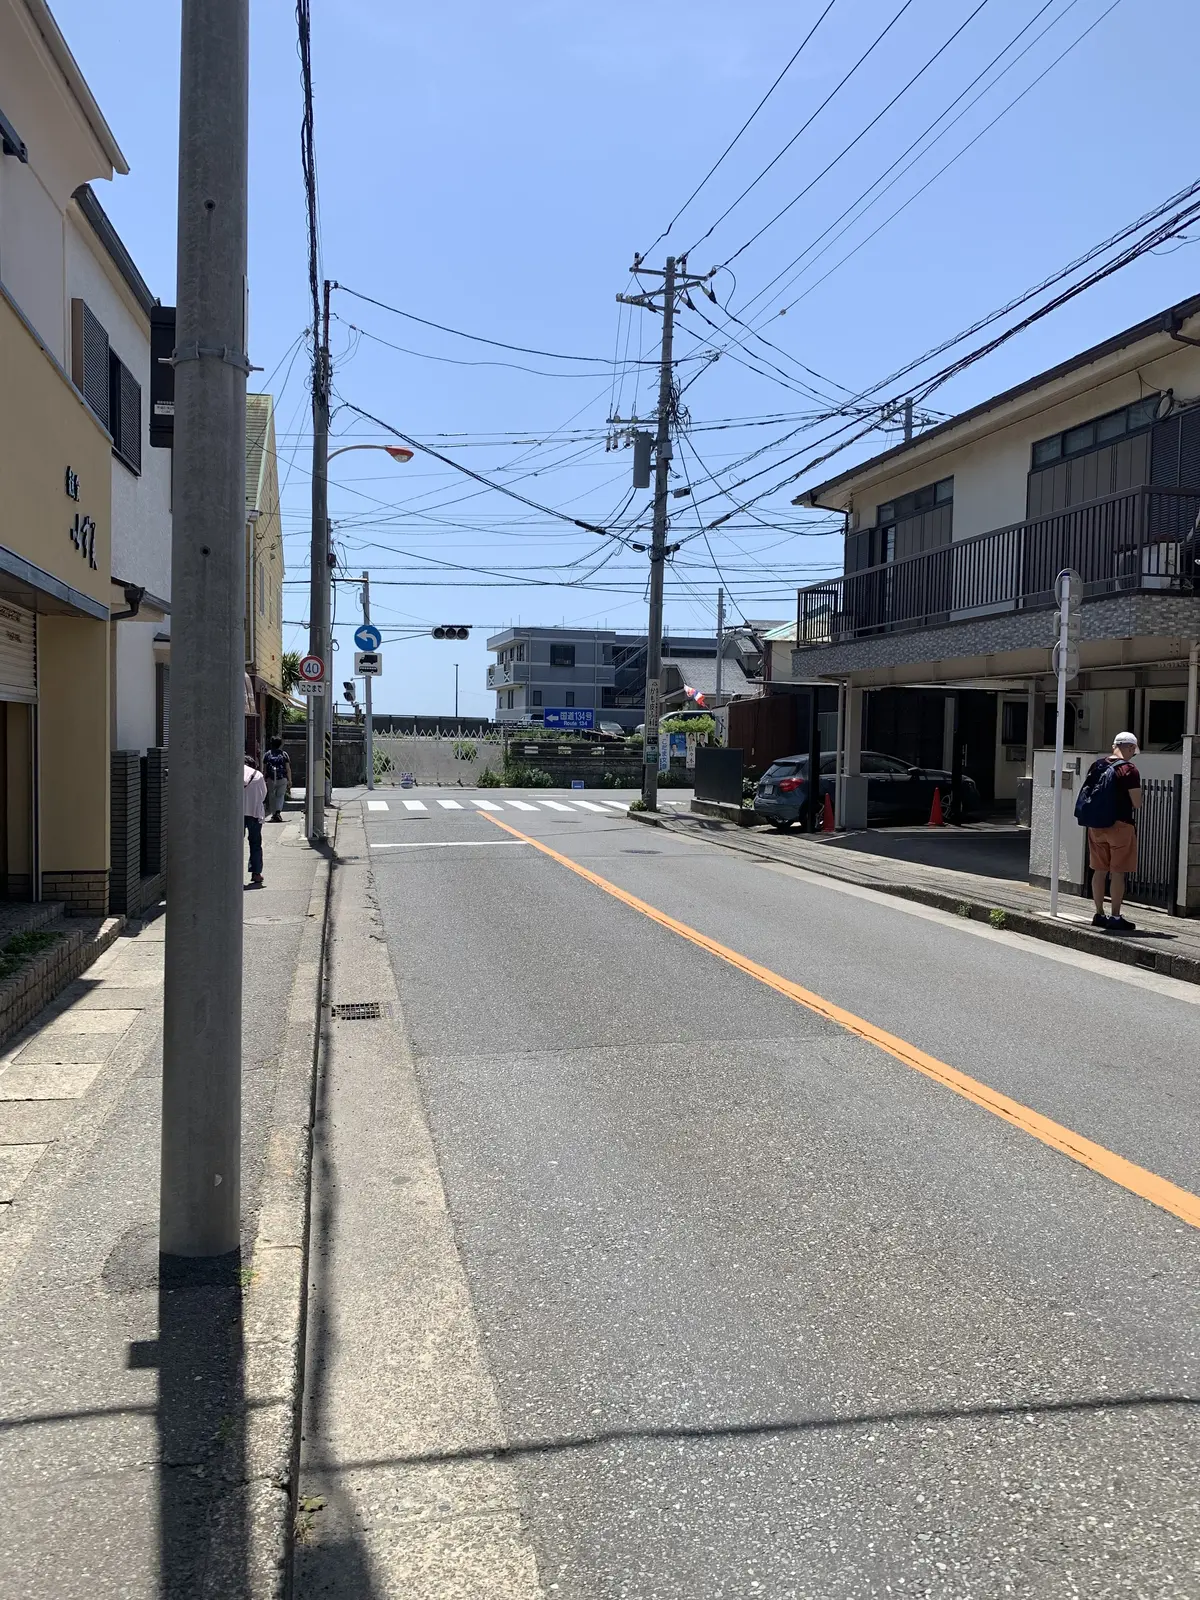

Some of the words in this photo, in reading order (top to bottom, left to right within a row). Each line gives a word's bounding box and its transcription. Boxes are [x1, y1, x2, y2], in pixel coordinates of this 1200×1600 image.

[305, 663, 319, 674] 40
[302, 685, 322, 693] ここまで
[560, 711, 592, 721] 国道134号
